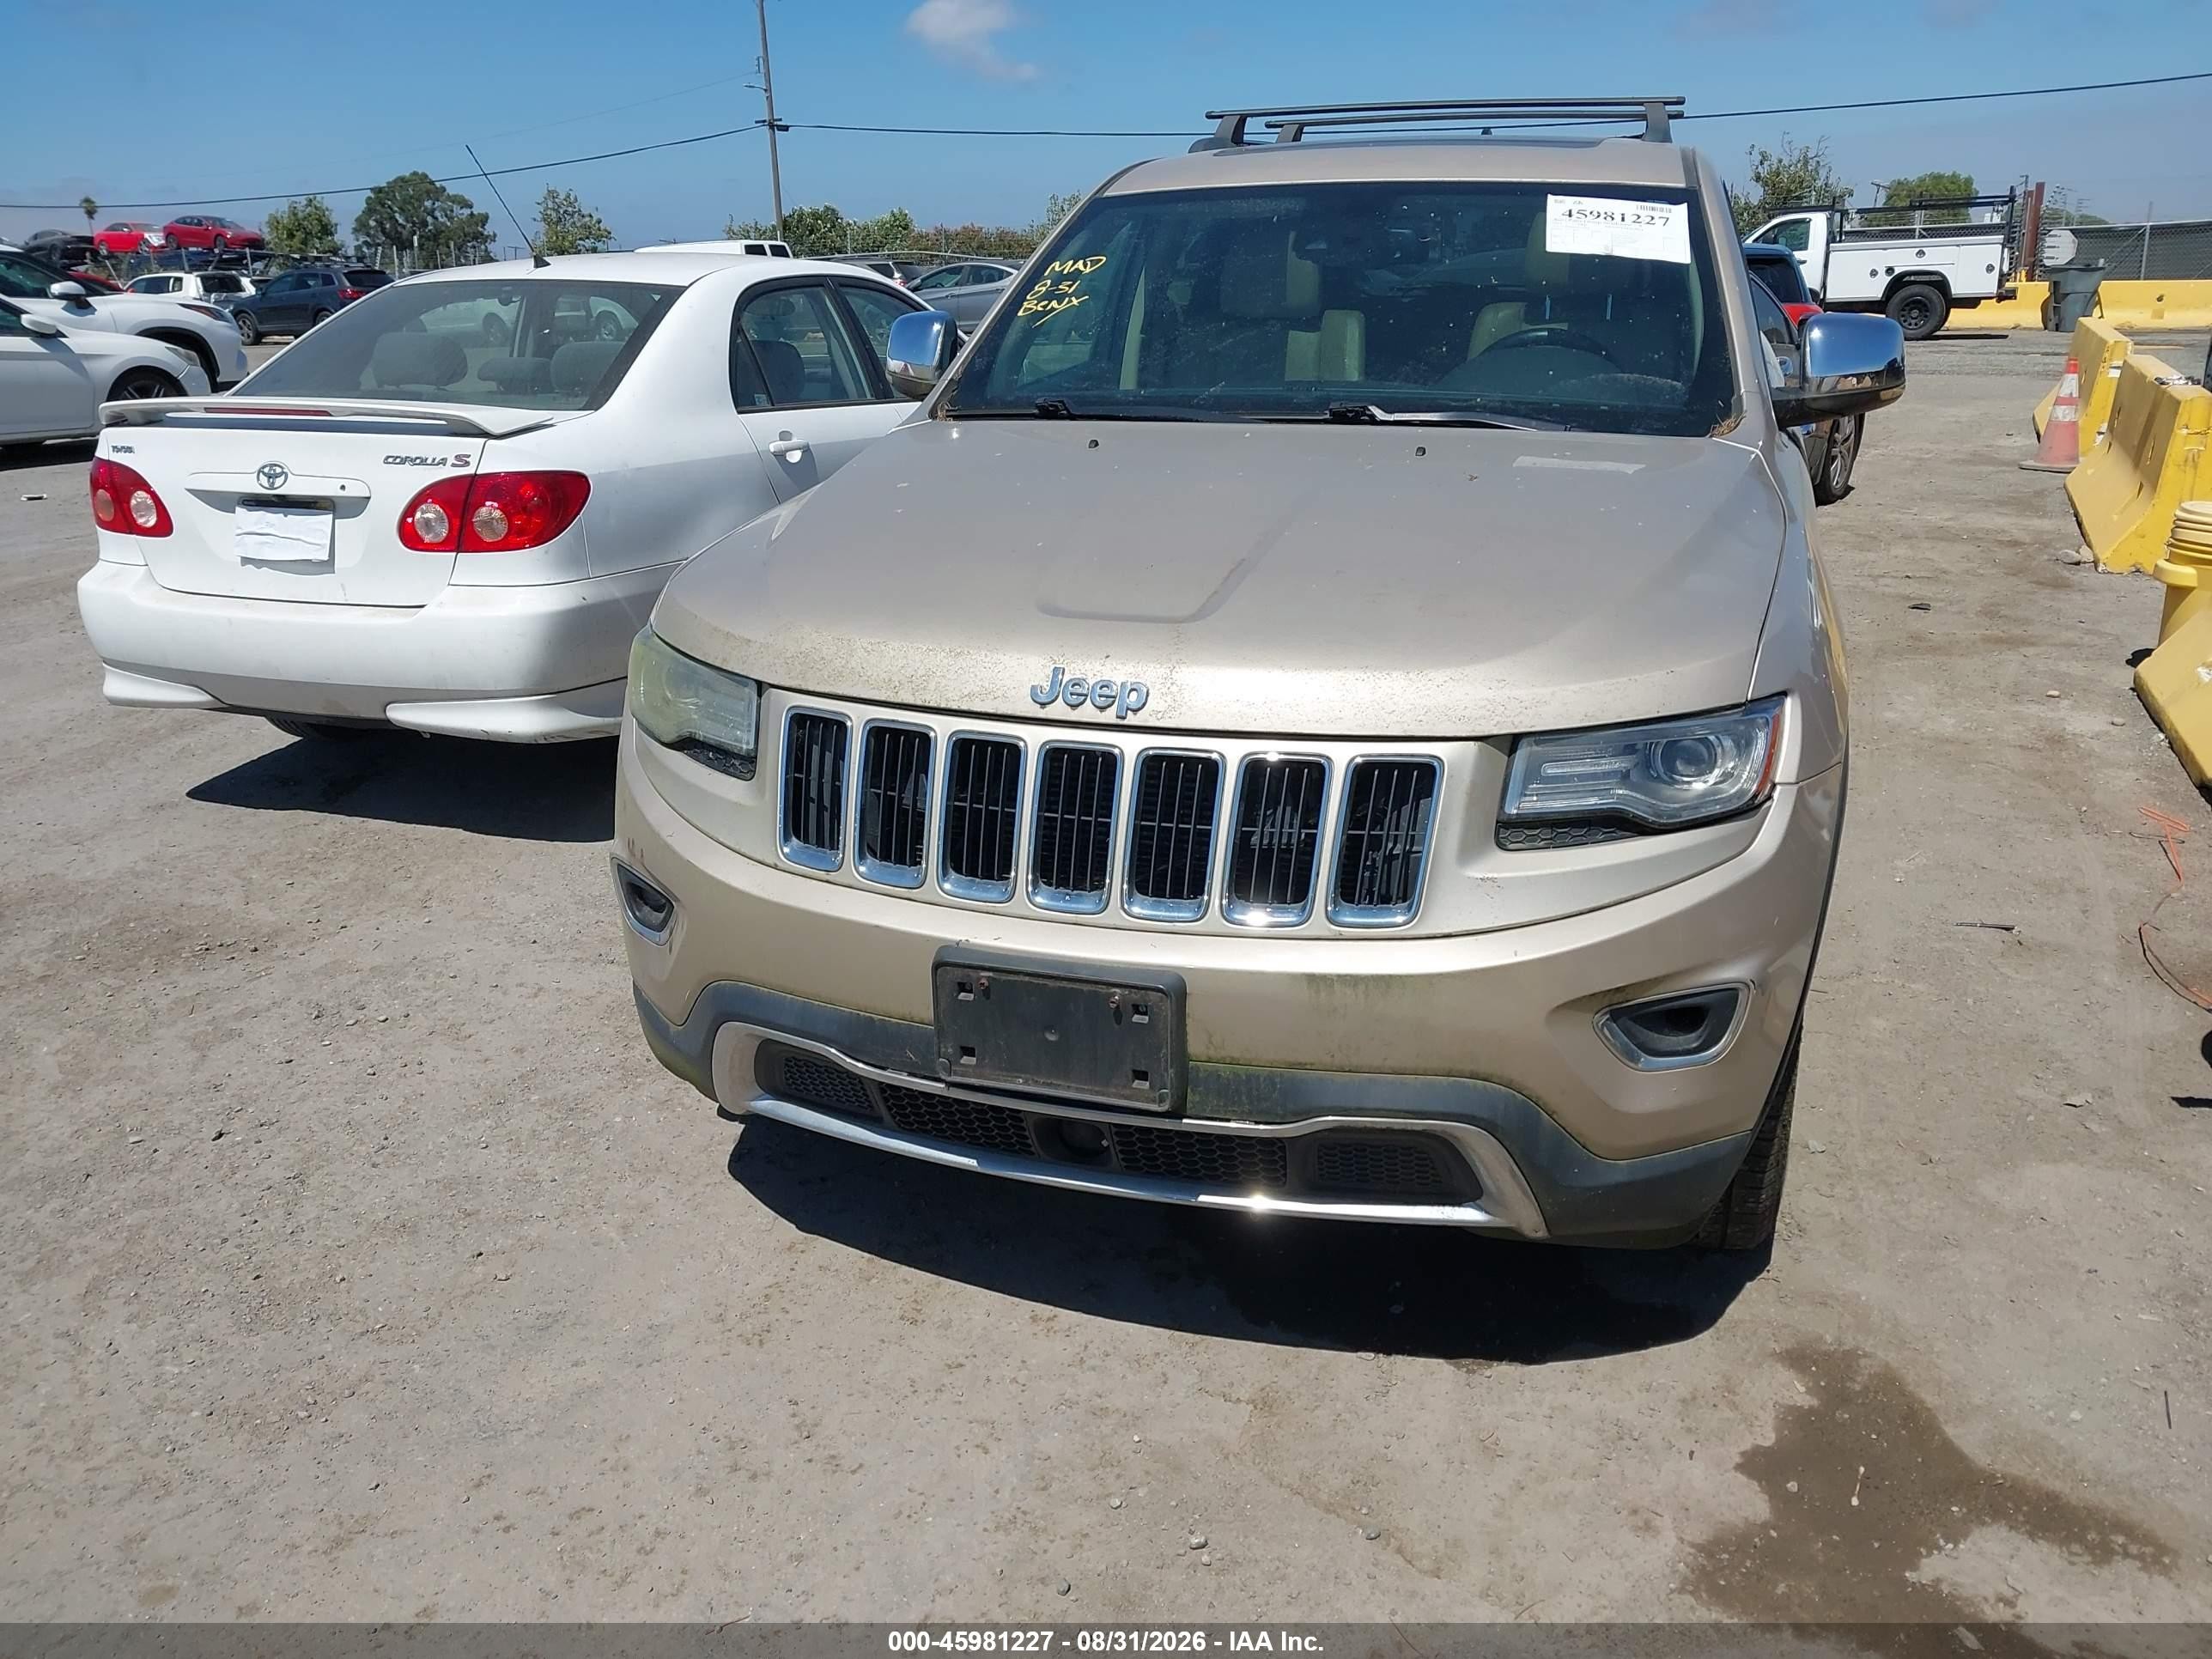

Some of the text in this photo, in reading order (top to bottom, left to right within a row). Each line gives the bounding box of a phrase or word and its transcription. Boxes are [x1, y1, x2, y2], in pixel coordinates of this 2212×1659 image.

[1561, 209, 1670, 227] 45981227
[1044, 256, 1106, 276] MAD
[383, 453, 471, 467] COROLLA S
[1030, 666, 1150, 720] Jeep
